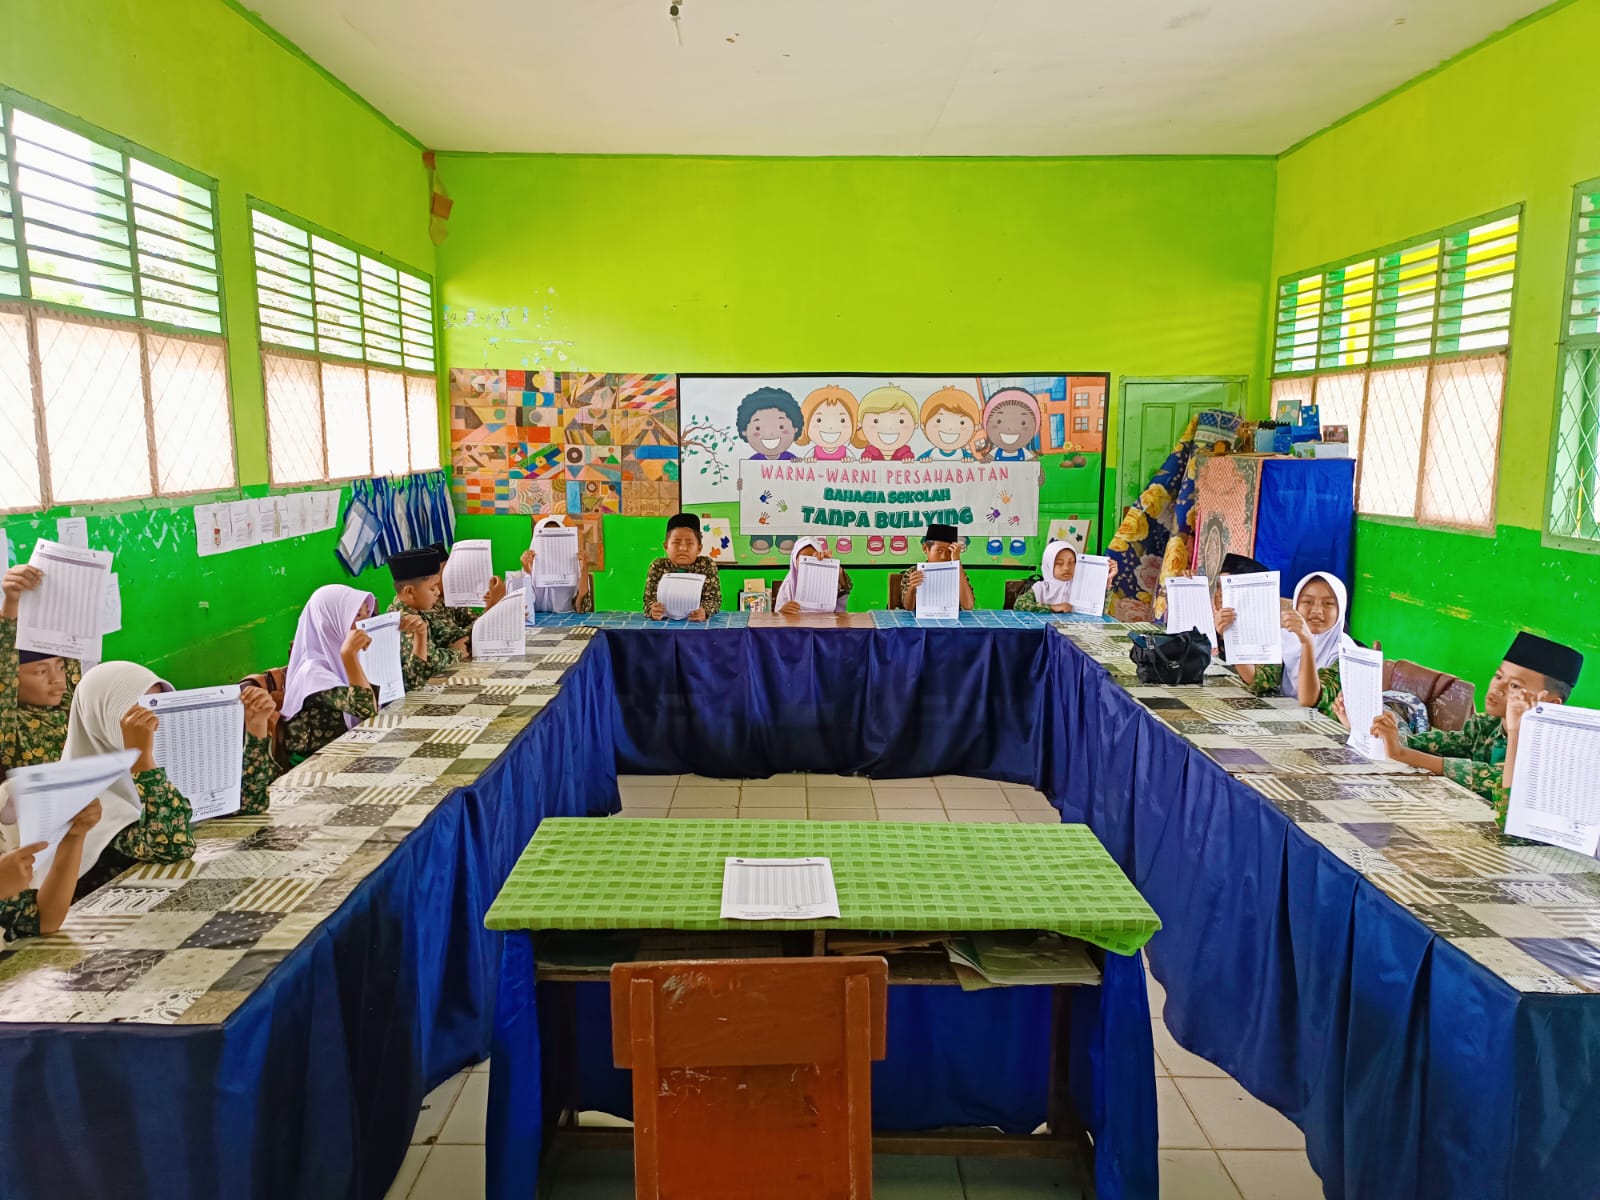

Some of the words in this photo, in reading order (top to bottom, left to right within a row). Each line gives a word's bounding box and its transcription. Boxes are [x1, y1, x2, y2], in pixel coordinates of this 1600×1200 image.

[760, 464, 877, 484] WARNA-WARNI
[887, 466, 1009, 485] PERSAHABATAN
[823, 486, 886, 504] BAHAGIA
[801, 505, 870, 528] TANPA
[874, 506, 974, 529] BULLYING
